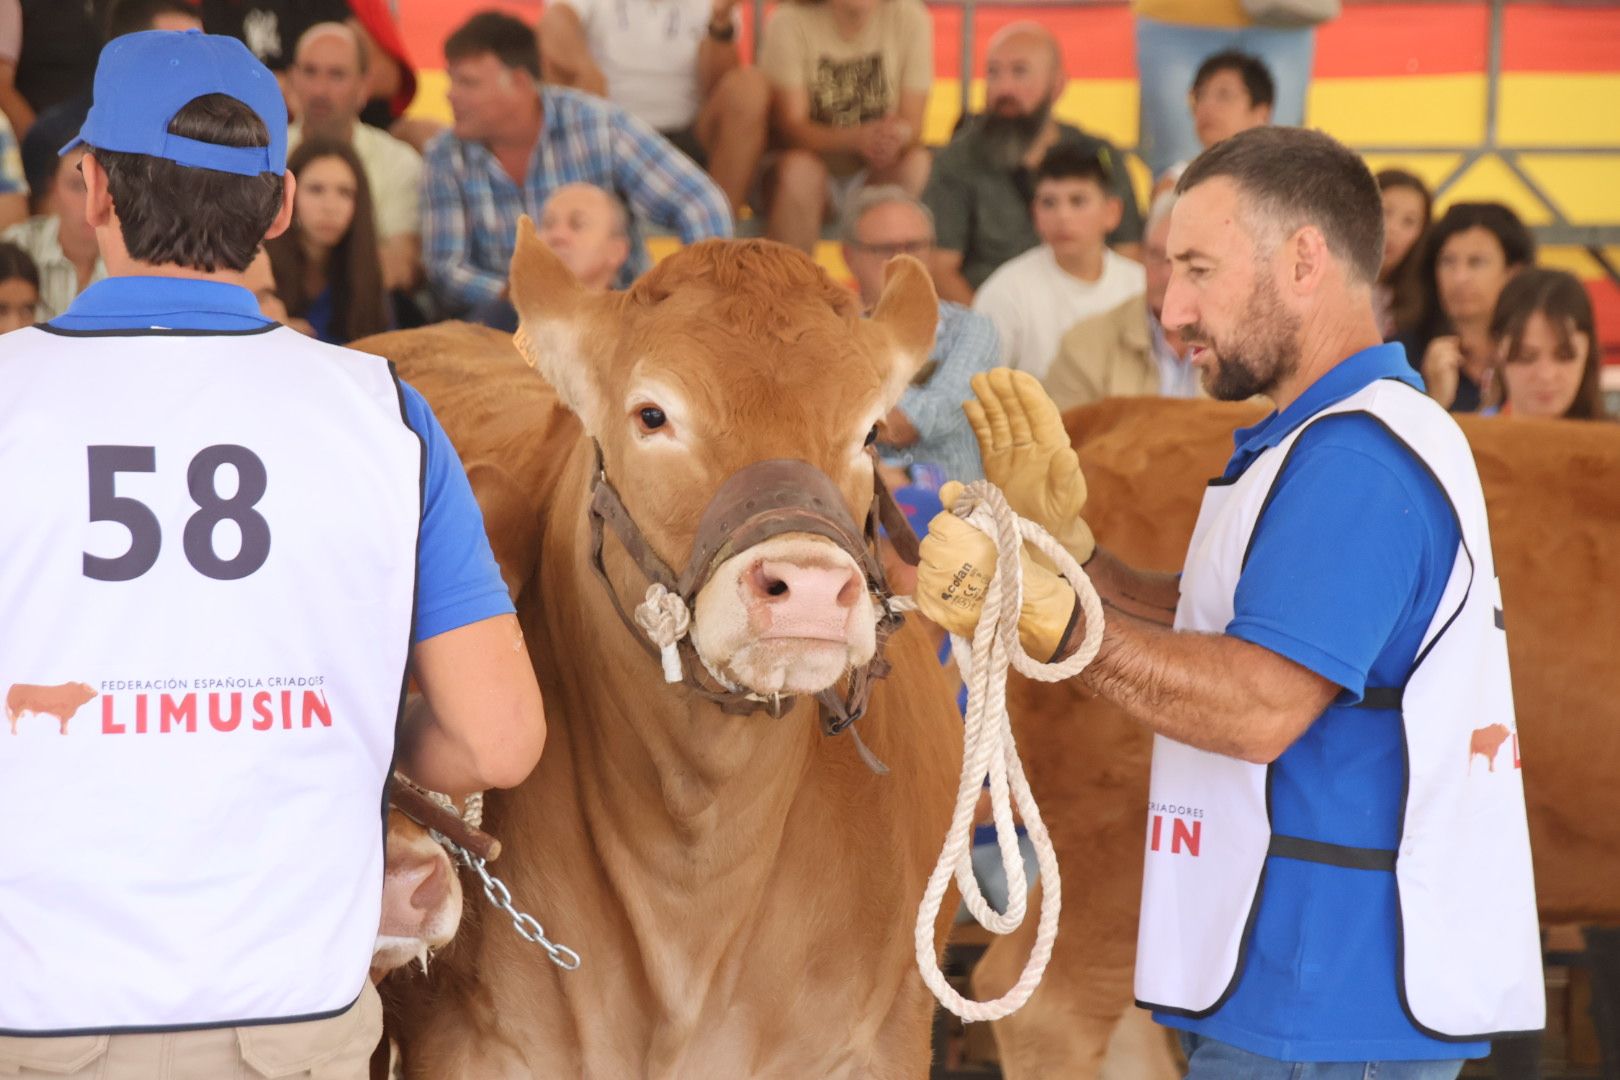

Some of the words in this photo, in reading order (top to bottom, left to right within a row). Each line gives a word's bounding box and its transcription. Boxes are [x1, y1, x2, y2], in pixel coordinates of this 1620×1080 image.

[82, 443, 271, 582] 58
[101, 678, 188, 691] FEDERACIÓN
[194, 676, 263, 689] ESPAÑOLA
[102, 689, 332, 735] LIMUSIN
[1148, 801, 1204, 818] RIADORES
